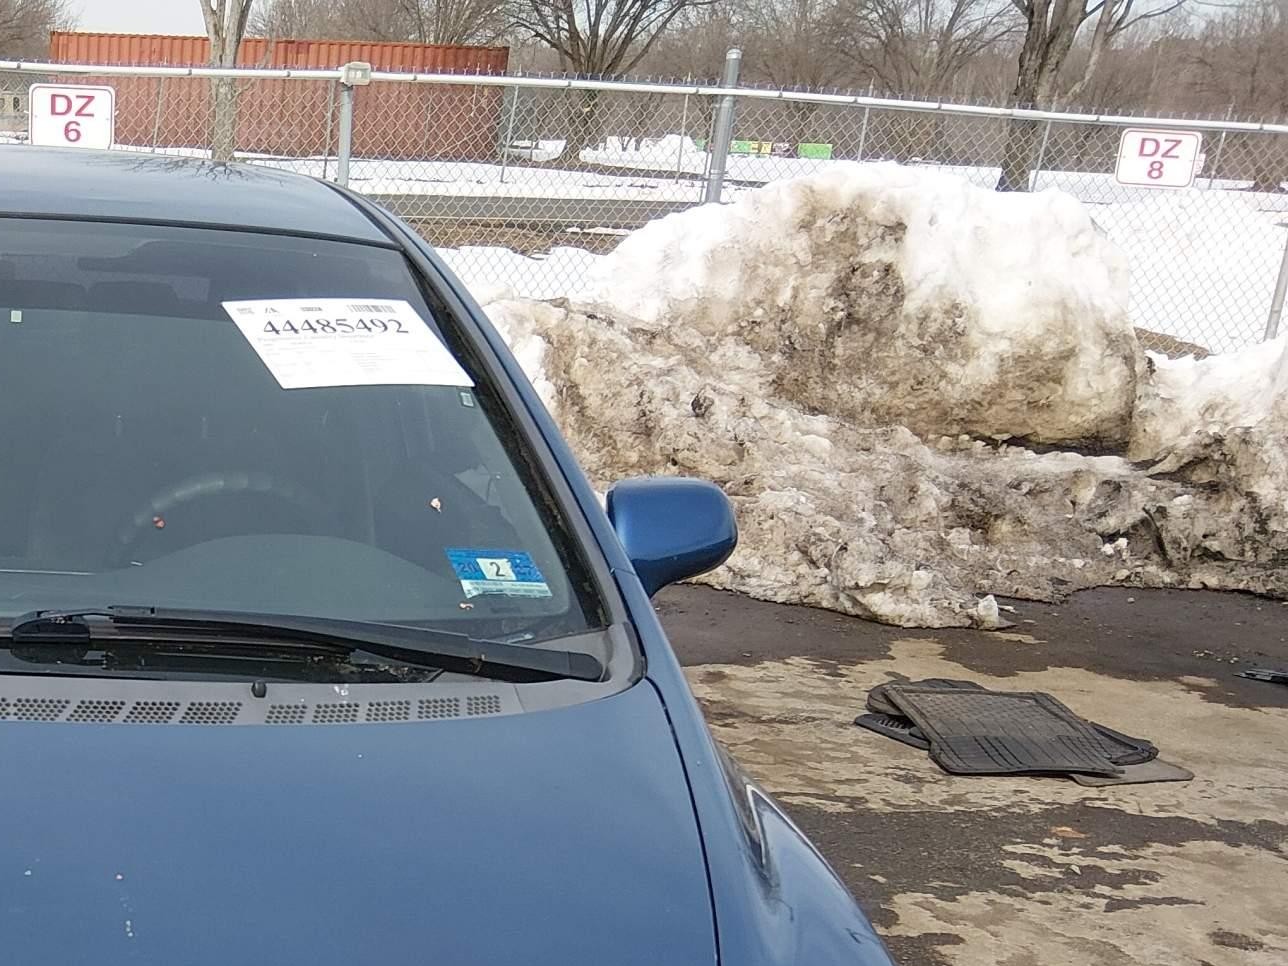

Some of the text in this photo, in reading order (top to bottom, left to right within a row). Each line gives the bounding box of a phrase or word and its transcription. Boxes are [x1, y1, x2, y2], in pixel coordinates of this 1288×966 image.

[50, 93, 95, 117] DZ
[64, 120, 81, 142] 6
[1138, 137, 1183, 159] DZ
[1147, 160, 1164, 180] 8
[263, 318, 409, 336] 44485492
[489, 561, 506, 577] 2
